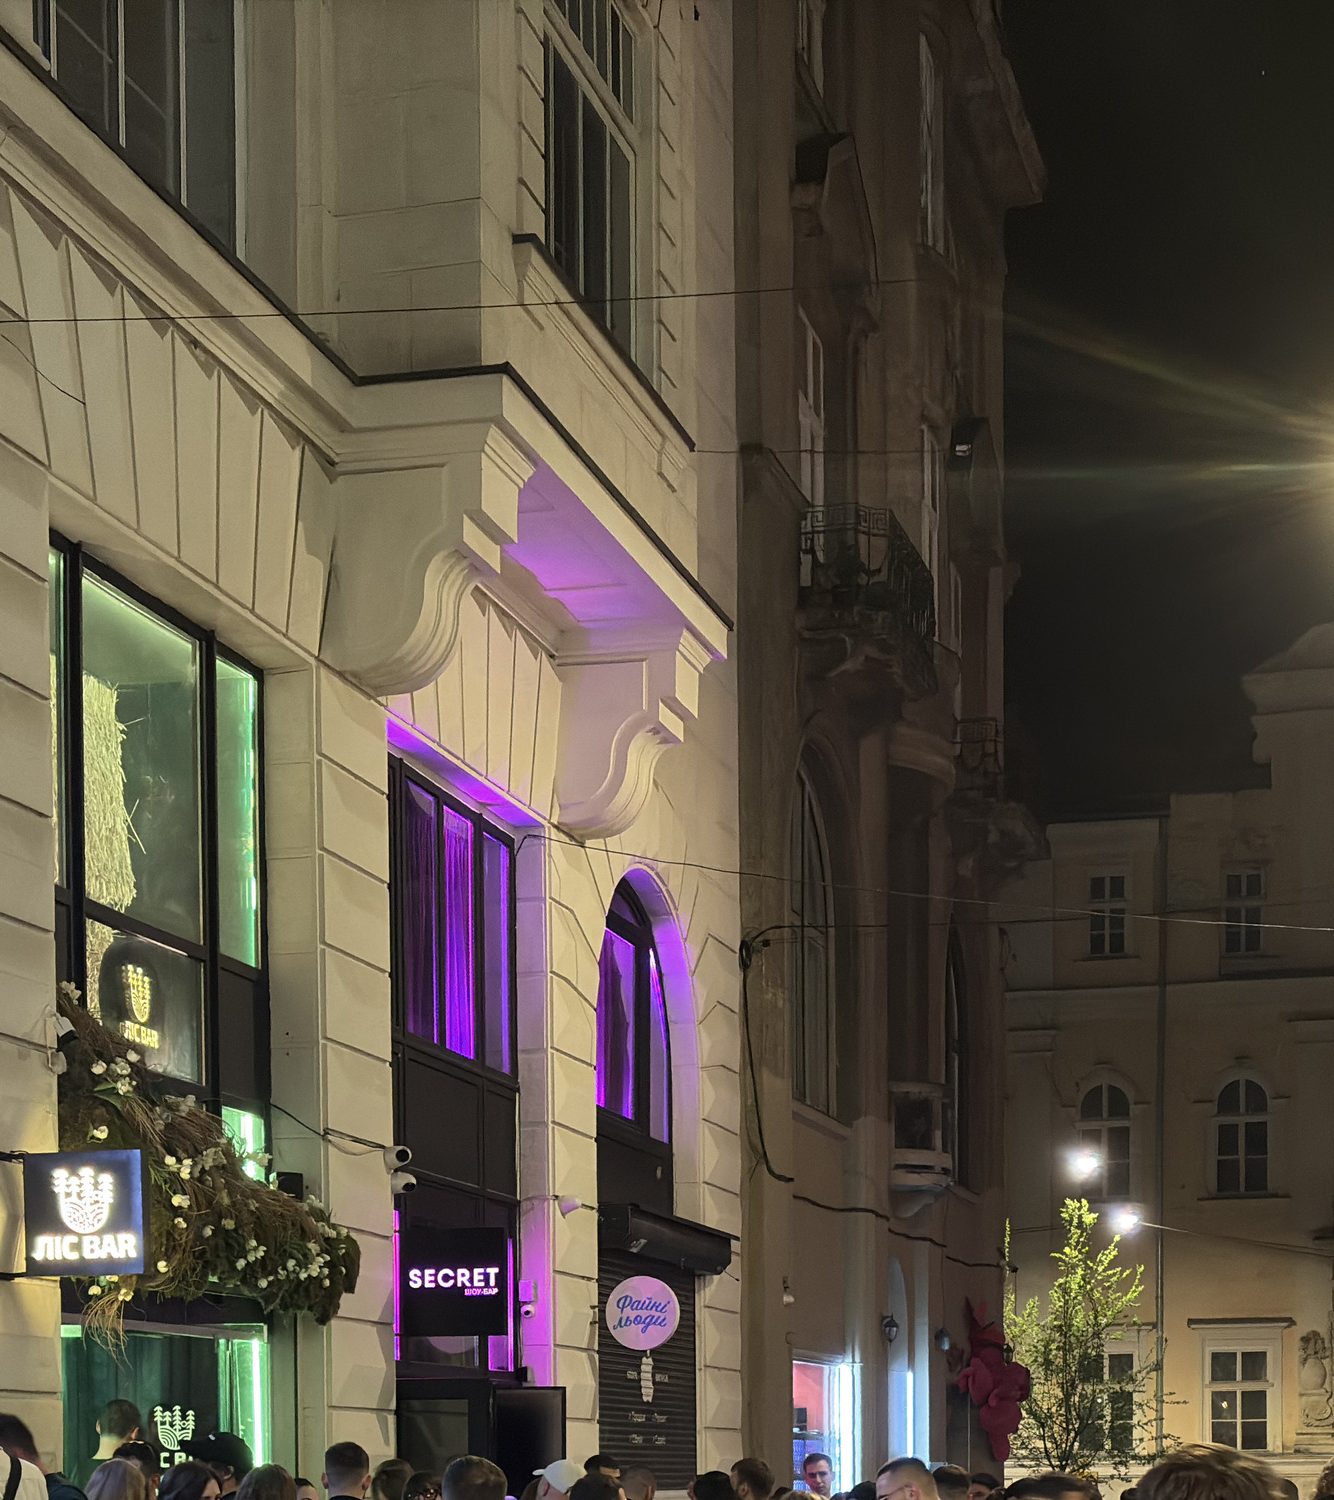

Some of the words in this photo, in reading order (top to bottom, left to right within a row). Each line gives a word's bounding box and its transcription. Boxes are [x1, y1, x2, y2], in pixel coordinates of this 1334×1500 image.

[82, 1233, 137, 1259] BAR
[408, 1267, 499, 1289] SECRET
[616, 1294, 671, 1314] Файні
[613, 1314, 667, 1334] льоди
